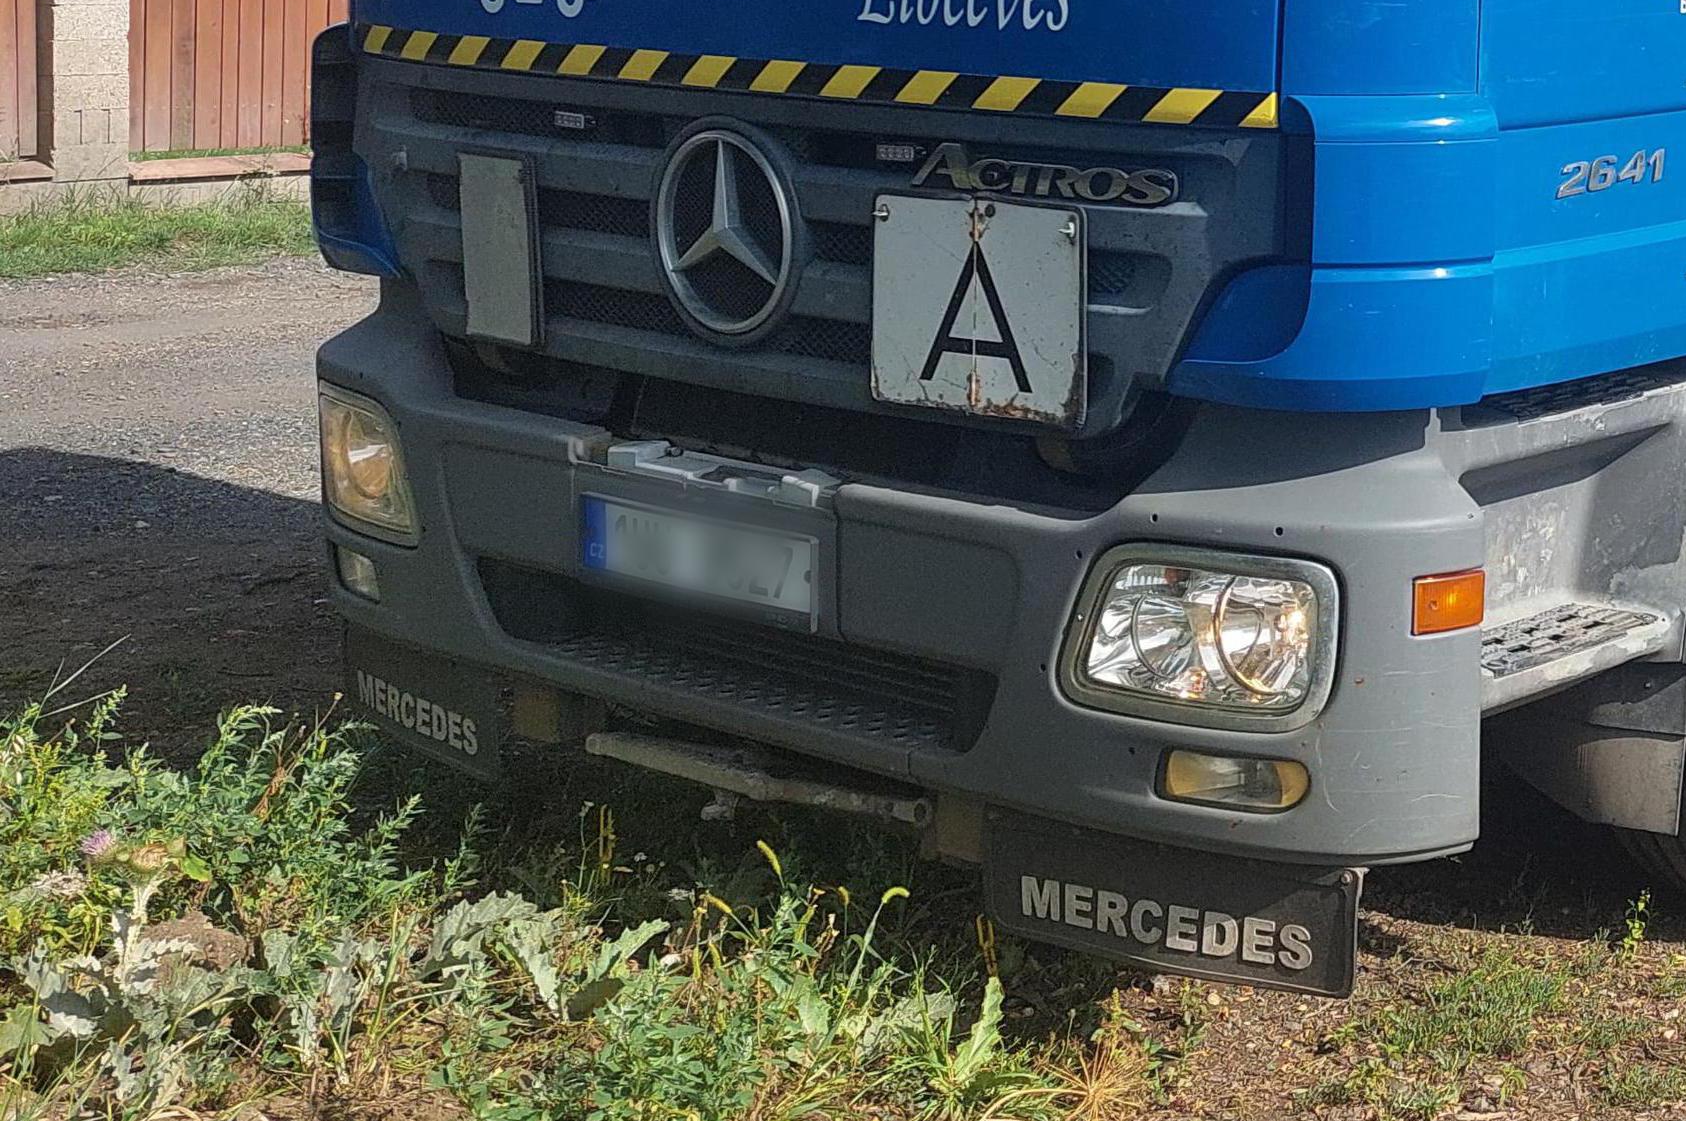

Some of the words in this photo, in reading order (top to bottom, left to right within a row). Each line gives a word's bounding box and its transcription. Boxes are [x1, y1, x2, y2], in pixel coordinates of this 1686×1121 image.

[1555, 148, 1666, 200] 2641
[919, 241, 1033, 393] A
[590, 542, 605, 559] CZ
[357, 670, 478, 756] MERCEDES
[1020, 875, 1313, 970] MERCEDES
